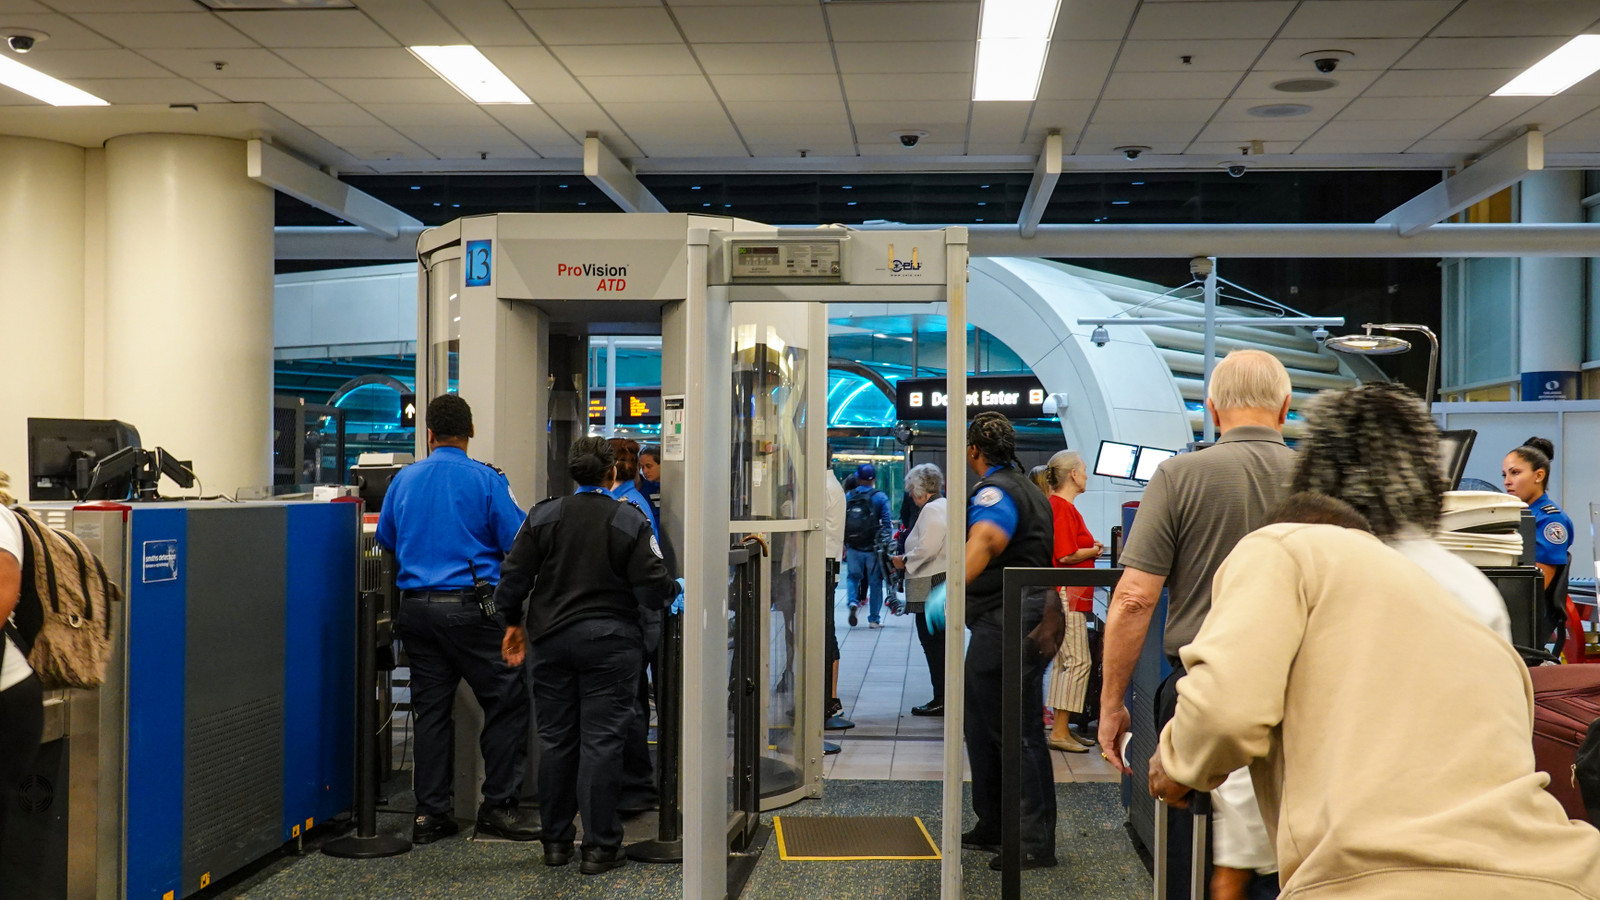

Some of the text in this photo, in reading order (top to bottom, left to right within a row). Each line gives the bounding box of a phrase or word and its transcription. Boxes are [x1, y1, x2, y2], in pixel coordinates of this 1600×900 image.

[467, 248, 490, 281] 13
[558, 263, 627, 277] ProVision
[597, 278, 626, 292] ATD
[982, 390, 1020, 405] Enter
